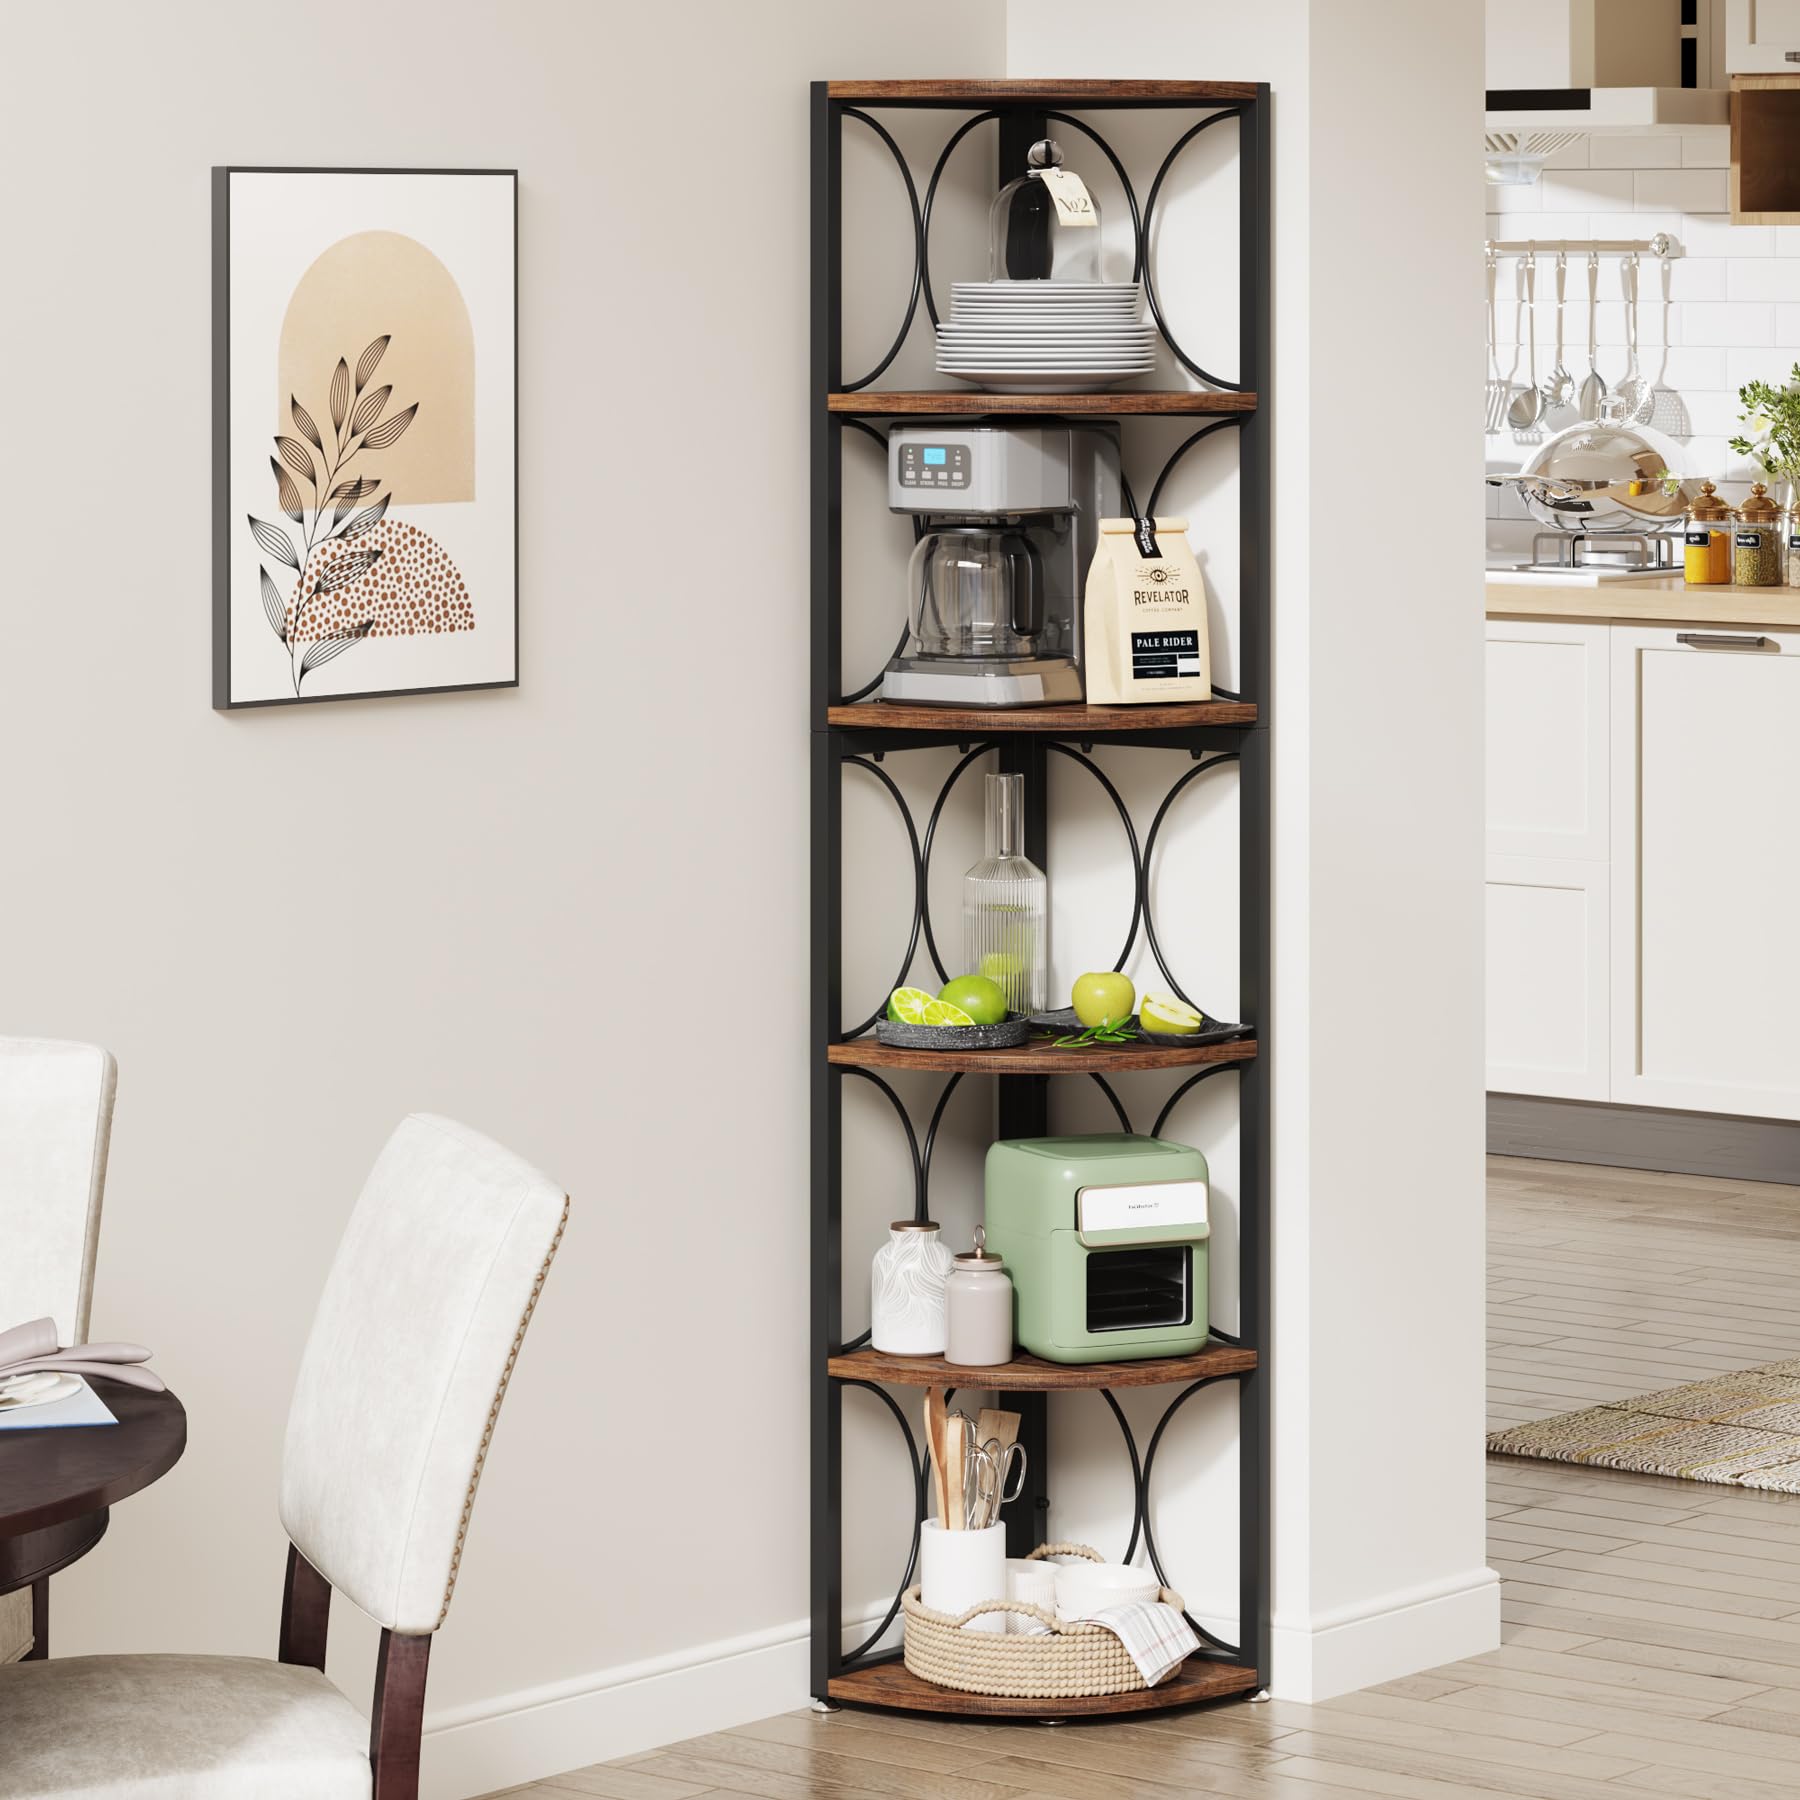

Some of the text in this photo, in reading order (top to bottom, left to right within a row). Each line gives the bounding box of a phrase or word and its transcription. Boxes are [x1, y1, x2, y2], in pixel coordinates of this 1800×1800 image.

[1133, 589, 1190, 606] REVELATOR
[1136, 636, 1193, 648] PALE RIDER
